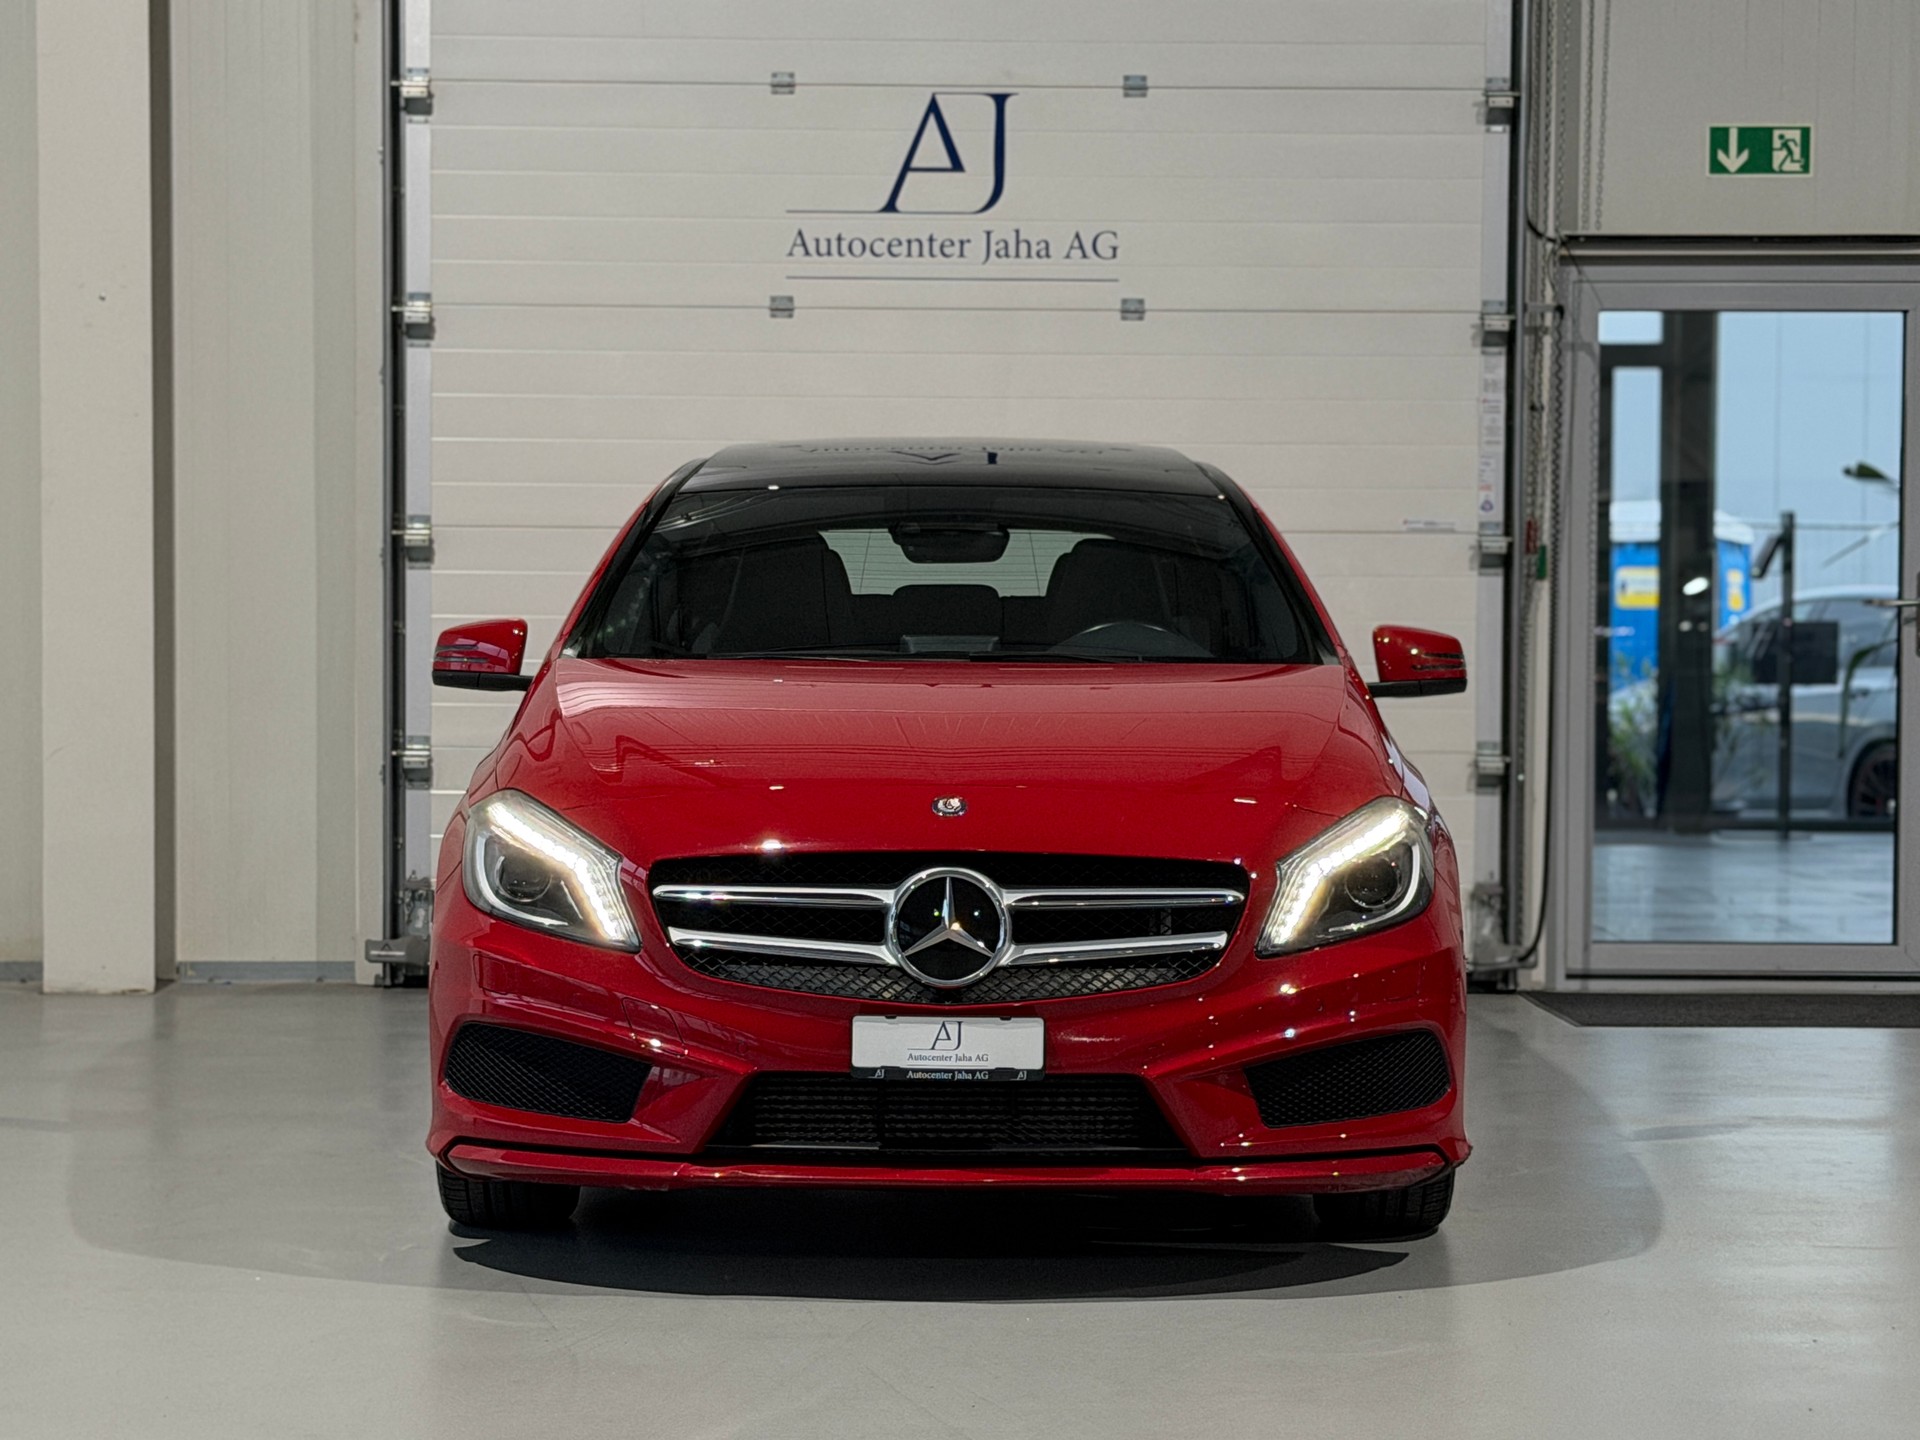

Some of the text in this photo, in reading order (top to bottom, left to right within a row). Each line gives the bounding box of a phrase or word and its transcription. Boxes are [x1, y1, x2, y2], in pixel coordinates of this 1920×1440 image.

[876, 92, 1018, 214] AJ
[786, 228, 1119, 265] Autocenter Jaha AG
[930, 1020, 964, 1051] AJ
[907, 1053, 989, 1063] Autocenter Jaha AG
[906, 1070, 989, 1080] Autocenter Jaha AG
